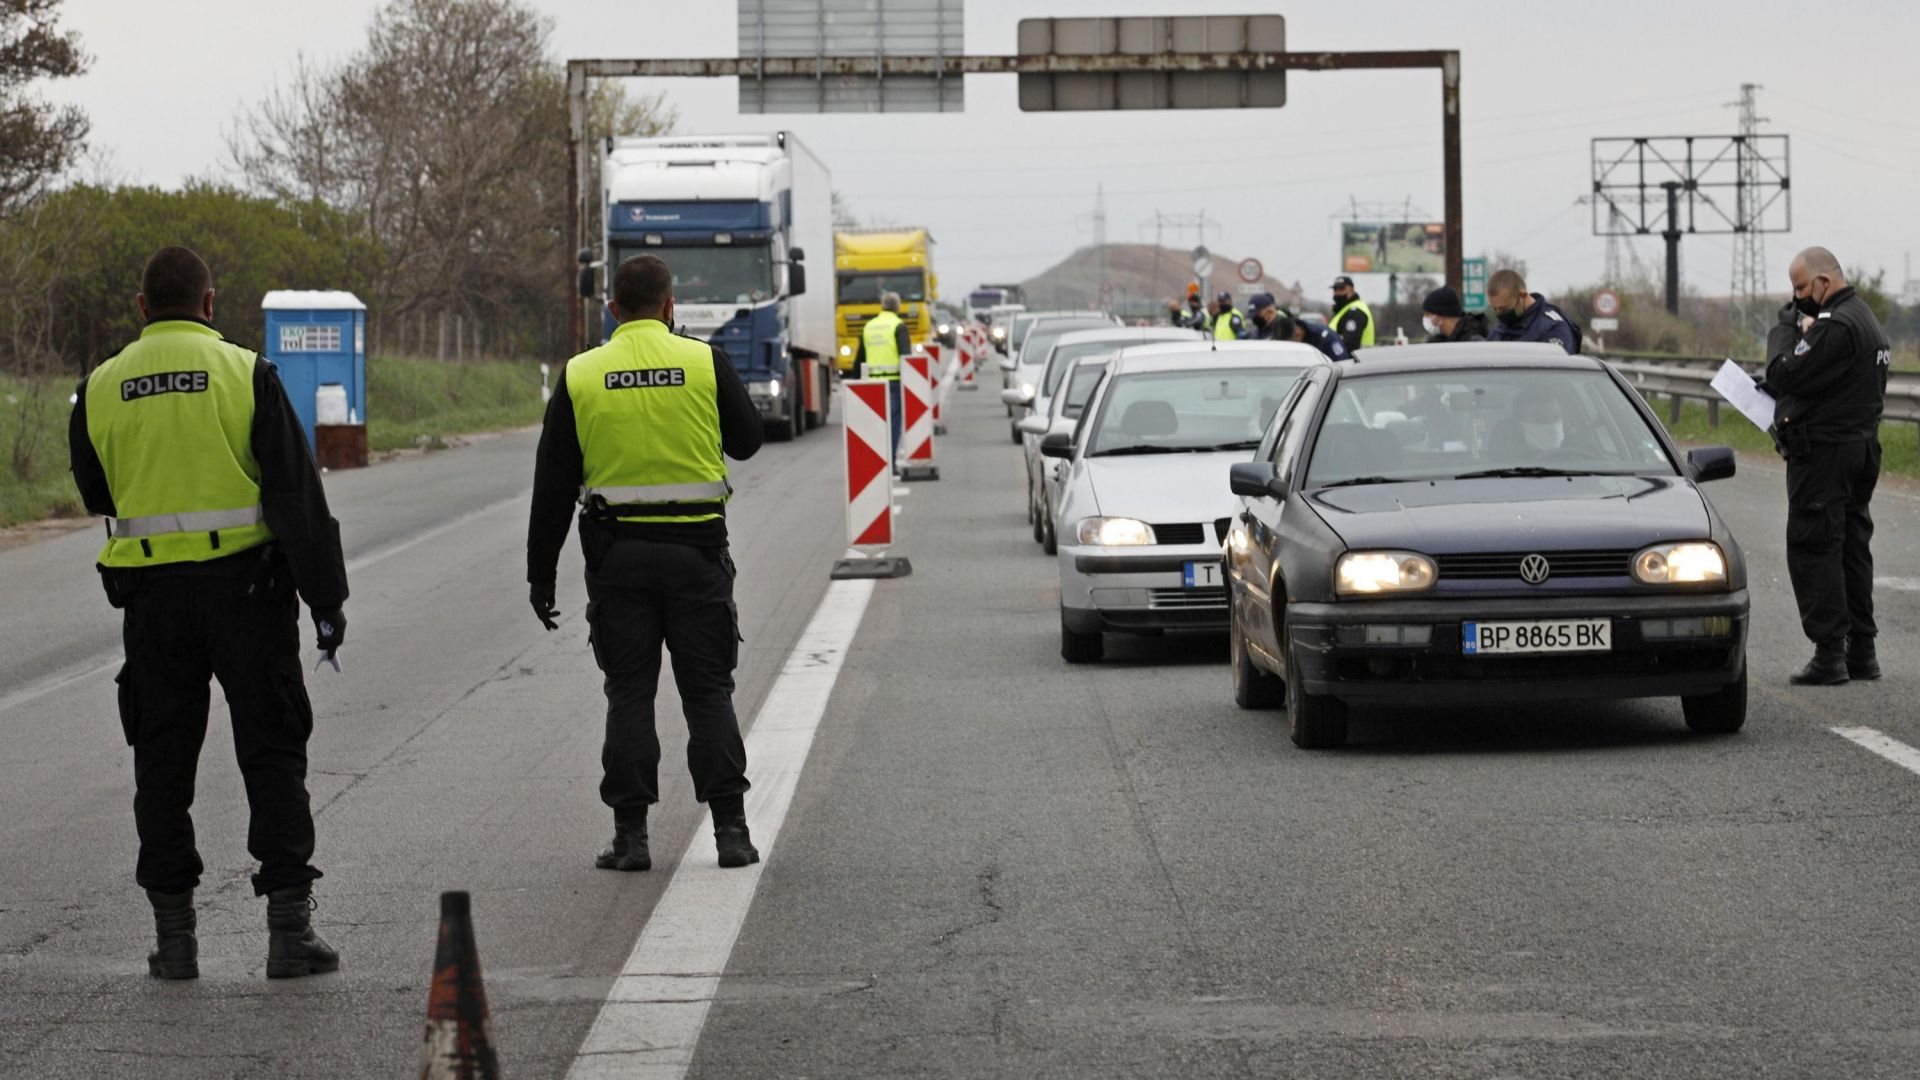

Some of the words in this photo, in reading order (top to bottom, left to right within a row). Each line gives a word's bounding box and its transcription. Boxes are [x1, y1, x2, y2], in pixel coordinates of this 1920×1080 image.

[123, 372, 206, 400] POLICE
[606, 369, 683, 389] POLICE
[1480, 626, 1510, 649] BP
[1515, 625, 1571, 648] 8865
[1576, 623, 1606, 647] BK
